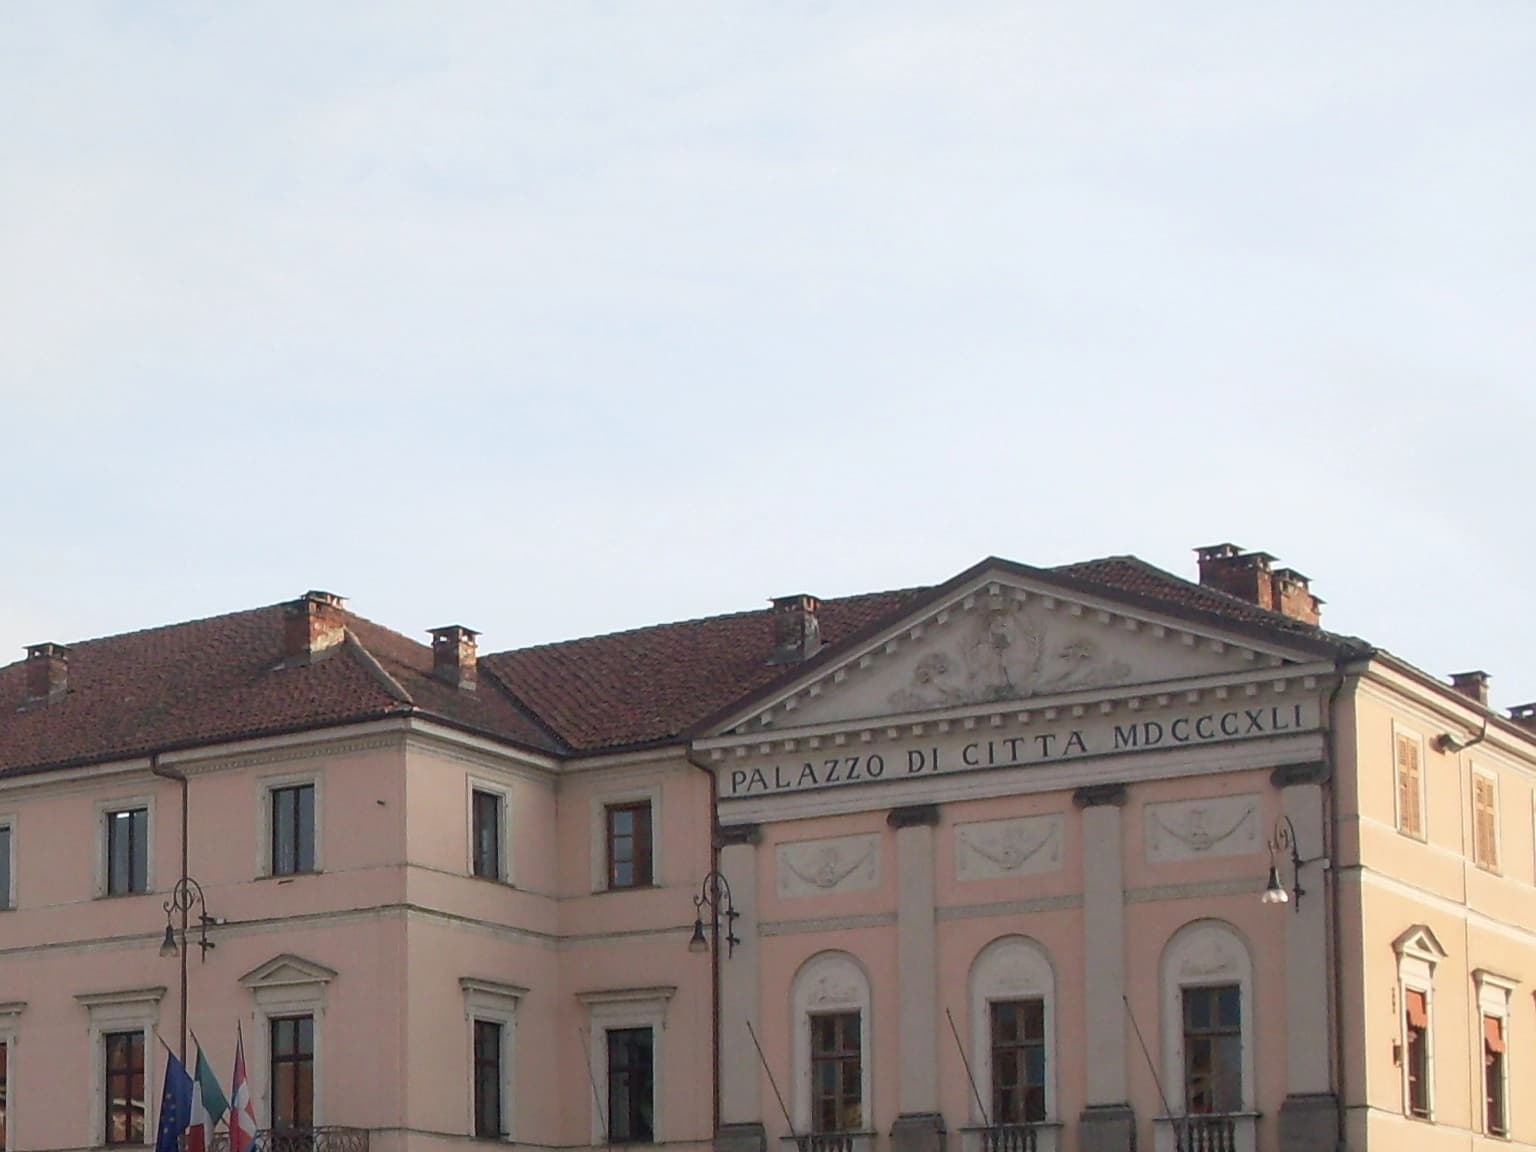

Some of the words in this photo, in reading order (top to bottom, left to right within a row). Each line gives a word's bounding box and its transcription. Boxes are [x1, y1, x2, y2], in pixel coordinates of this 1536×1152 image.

[731, 754, 885, 793] PALAZZO
[908, 747, 939, 773] DI
[1114, 704, 1303, 750] MDCCCXLI
